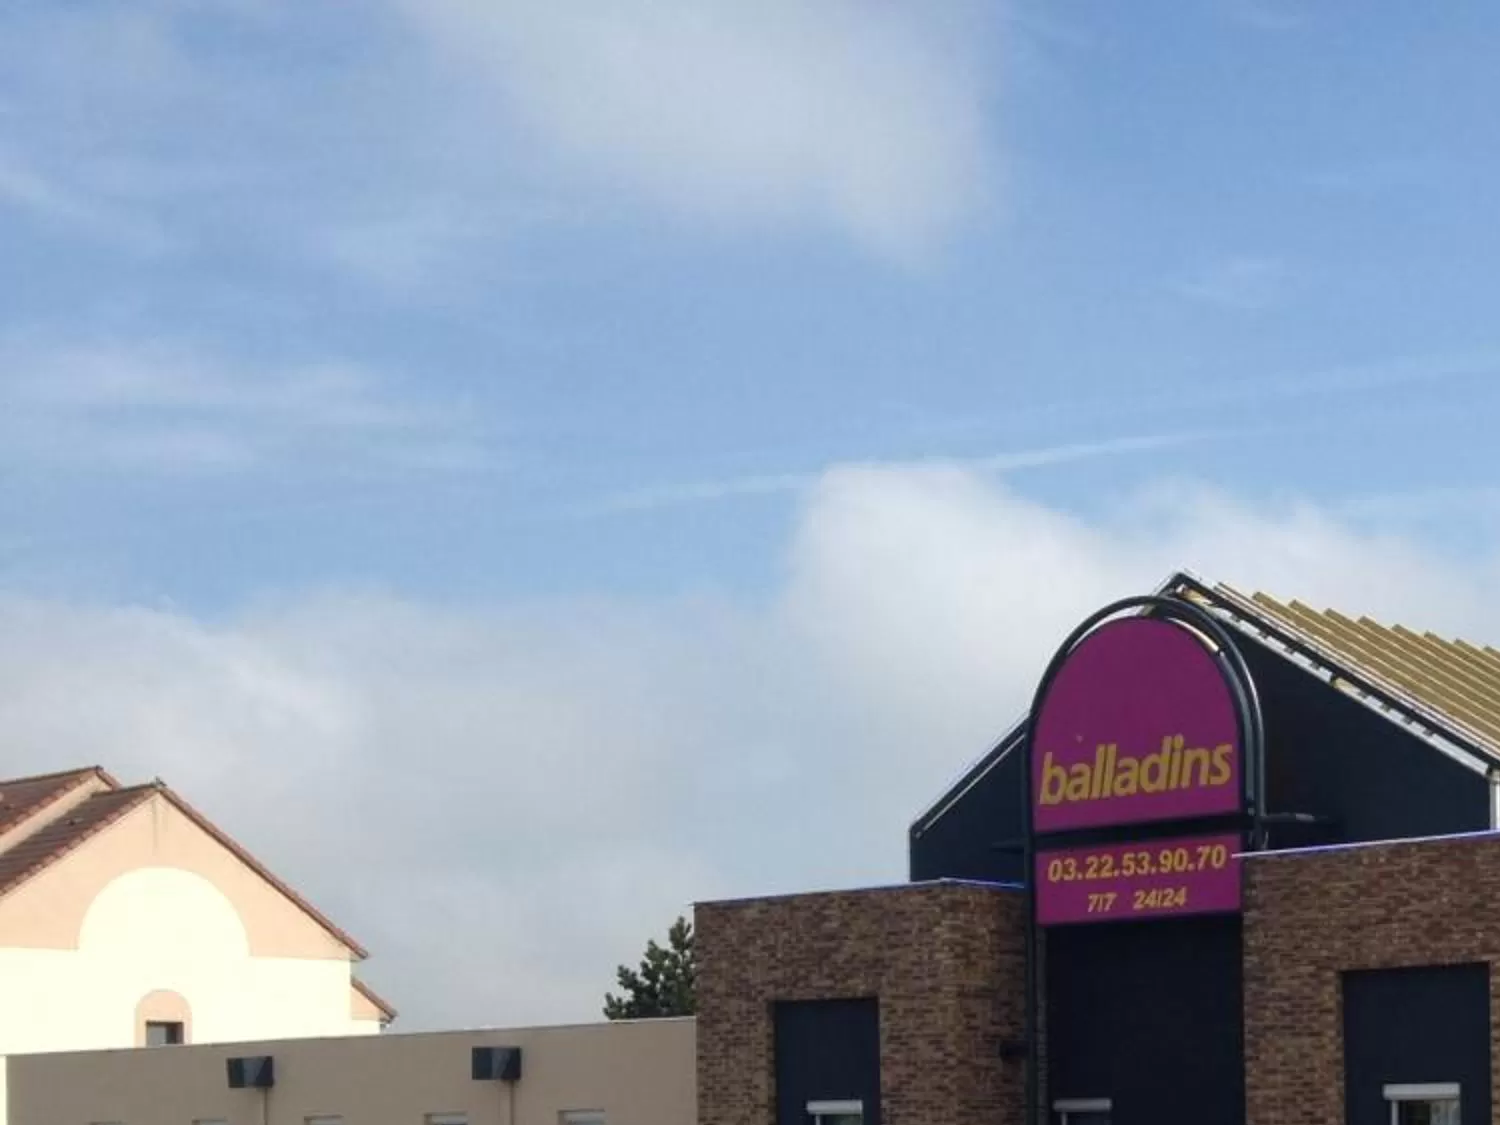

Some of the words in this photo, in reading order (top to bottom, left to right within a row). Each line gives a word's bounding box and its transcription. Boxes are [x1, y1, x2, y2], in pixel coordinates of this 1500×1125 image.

[1039, 734, 1234, 805] balladins
[1048, 844, 1226, 882] 03.22.53.90.70
[1087, 892, 1118, 912] 7/7
[1133, 887, 1188, 910] 24/24
